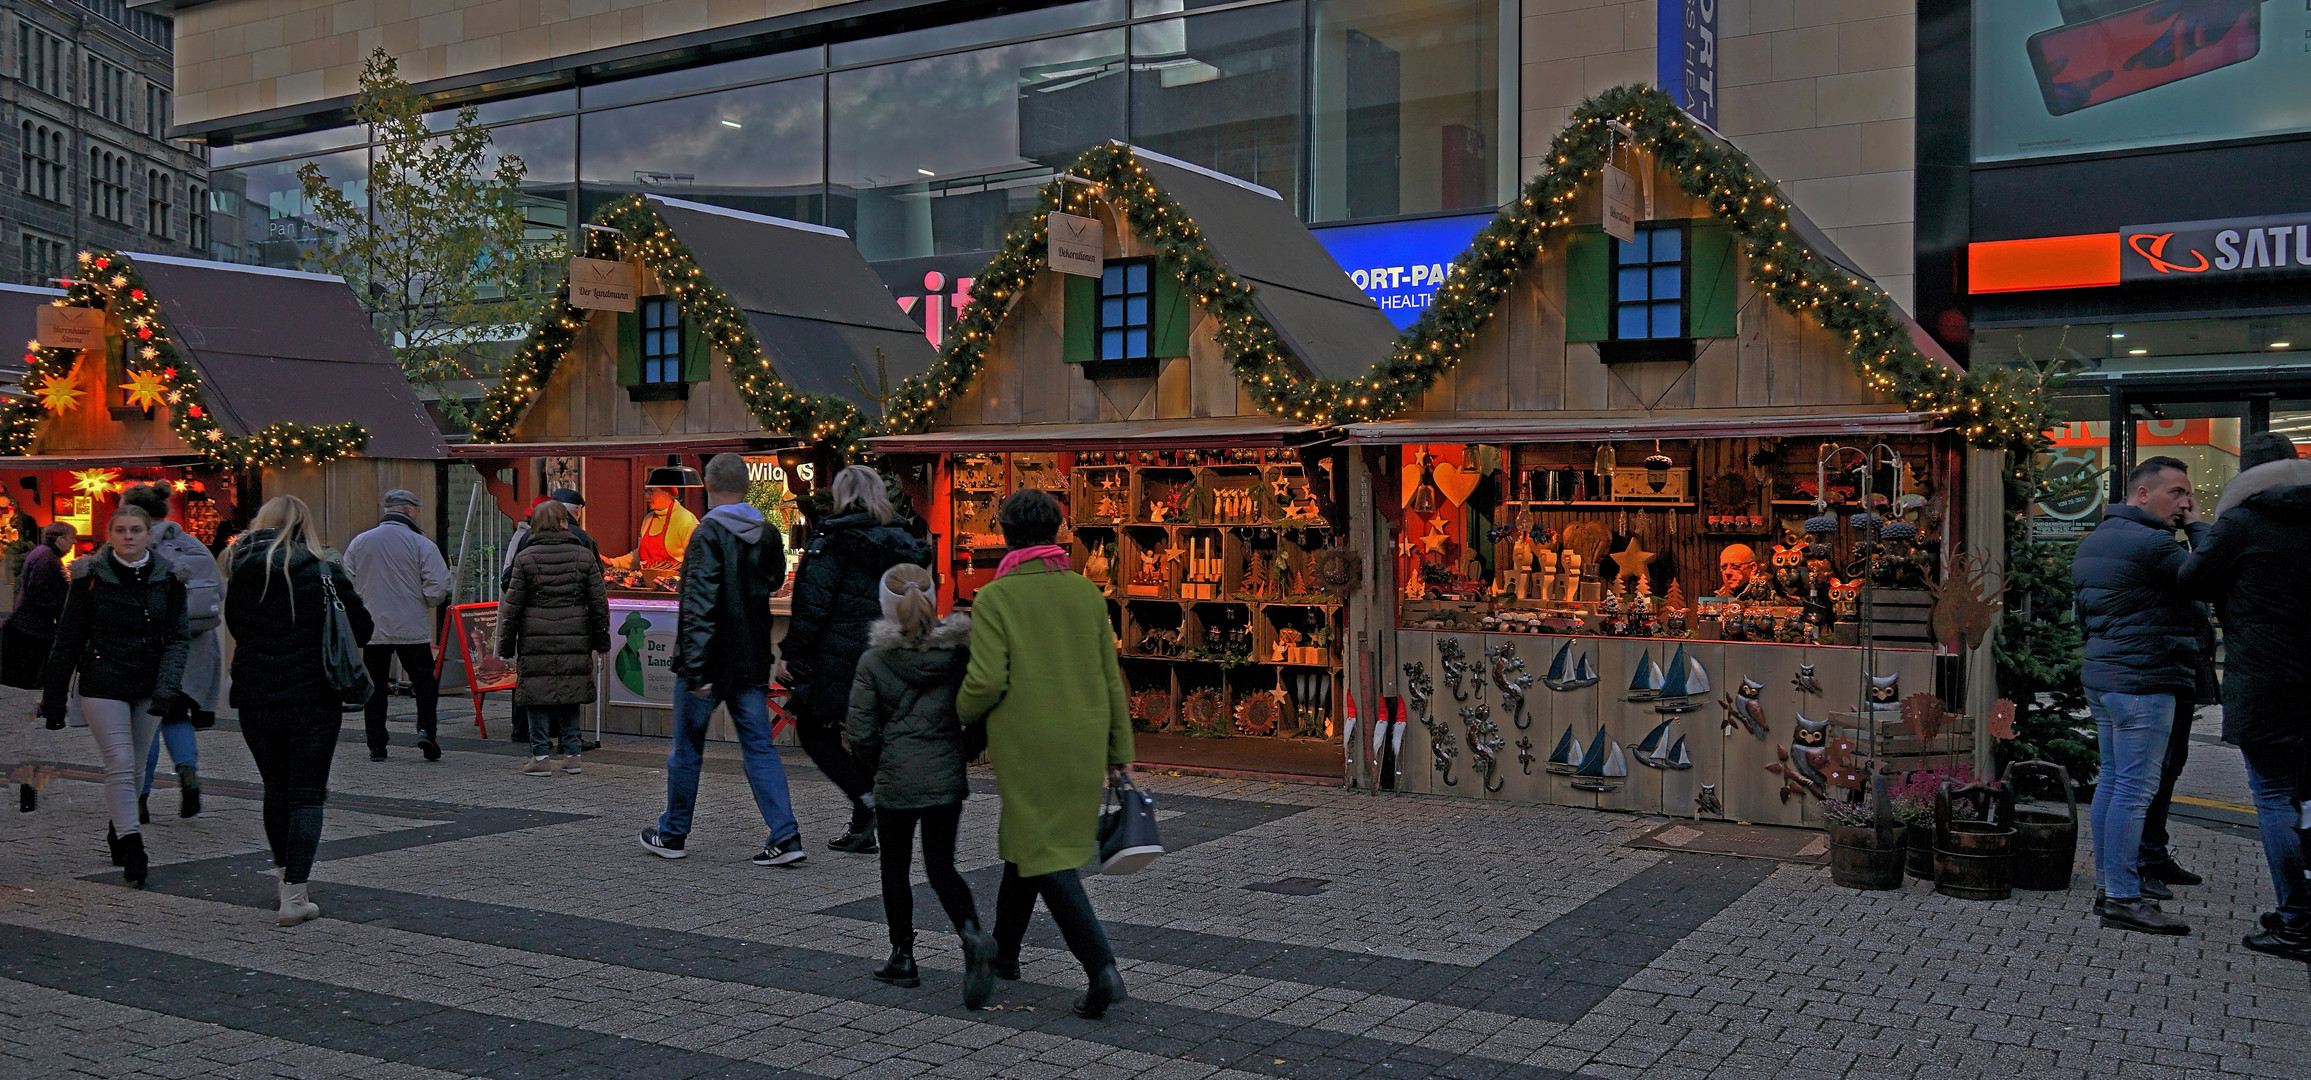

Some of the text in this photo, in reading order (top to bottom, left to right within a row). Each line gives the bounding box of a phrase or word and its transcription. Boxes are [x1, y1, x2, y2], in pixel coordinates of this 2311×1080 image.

[269, 222, 295, 237] Pan
[1057, 246, 1096, 263] Dekorationen
[579, 286, 629, 300] Der Landmann
[647, 640, 666, 652] Der
